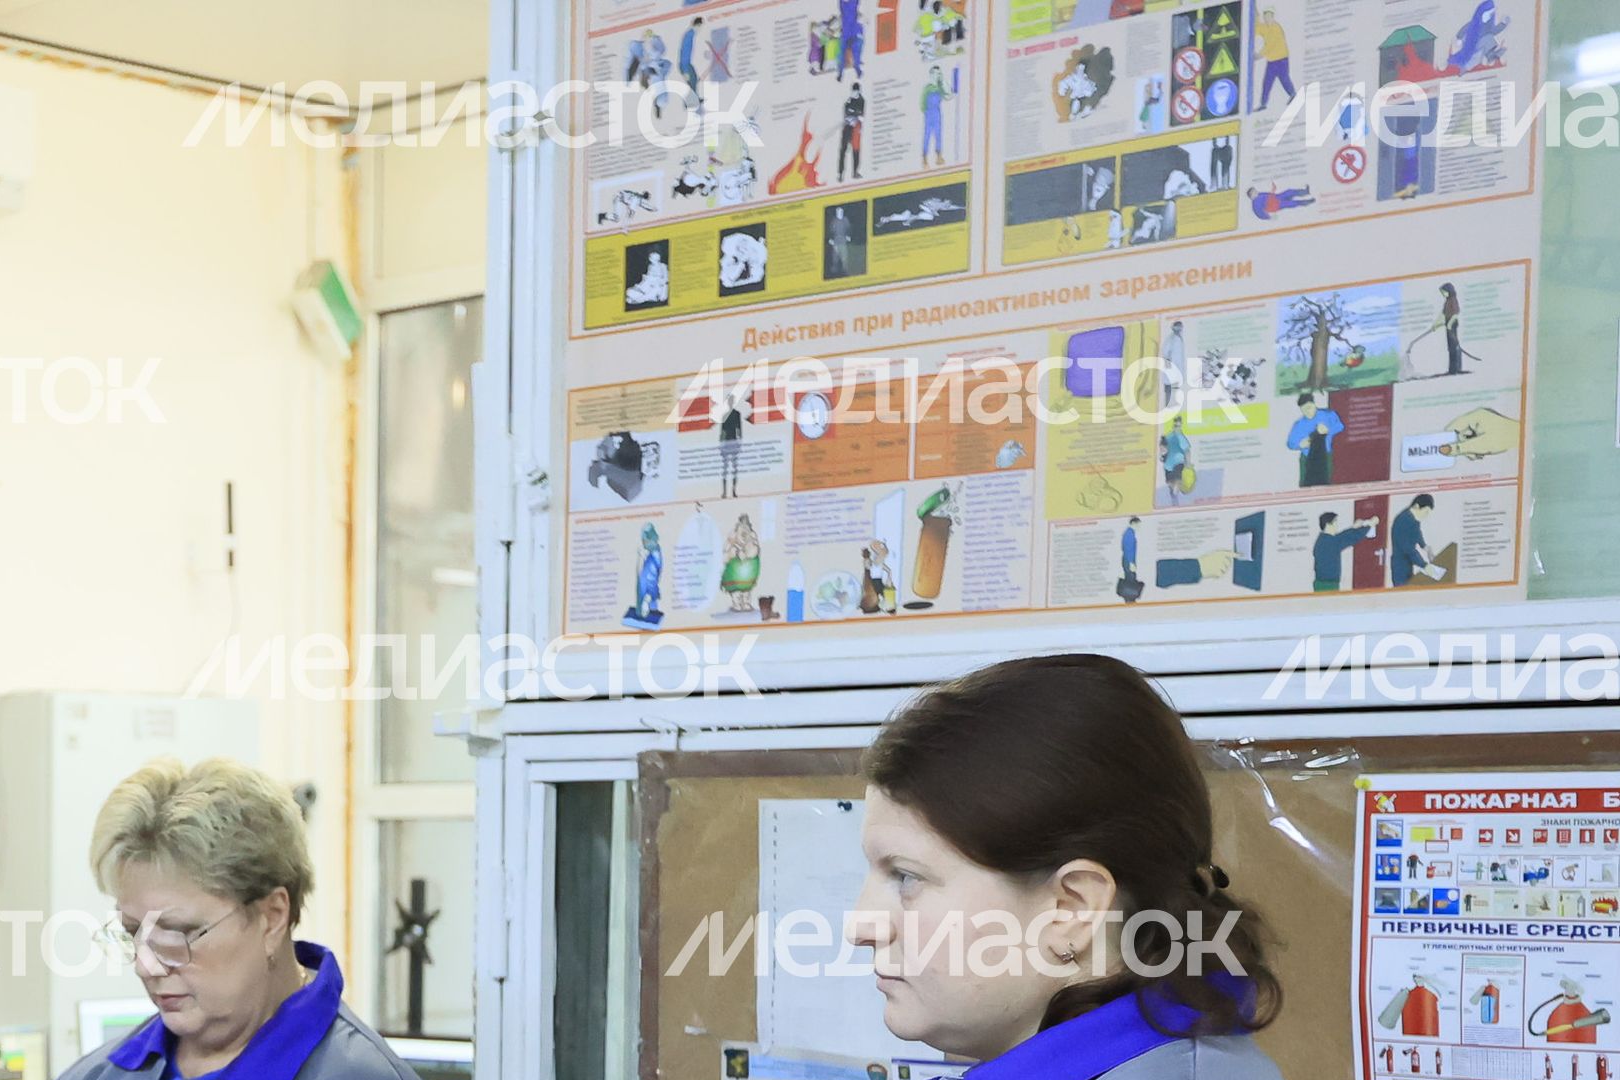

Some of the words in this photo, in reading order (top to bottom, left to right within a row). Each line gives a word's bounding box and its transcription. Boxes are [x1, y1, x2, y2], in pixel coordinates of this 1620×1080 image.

[741, 319, 846, 352] Действия
[853, 314, 894, 338] при
[901, 283, 1091, 331] радиоактивном
[1099, 260, 1254, 301] заражении
[1424, 791, 1578, 810] ПОЖАРНАЯ
[1603, 791, 1620, 808] Б
[1572, 818, 1620, 827] ПОЖАРНО
[1381, 920, 1519, 937] ПЕРВИЧНЫЕ
[1526, 923, 1620, 940] СРЕДСТ
